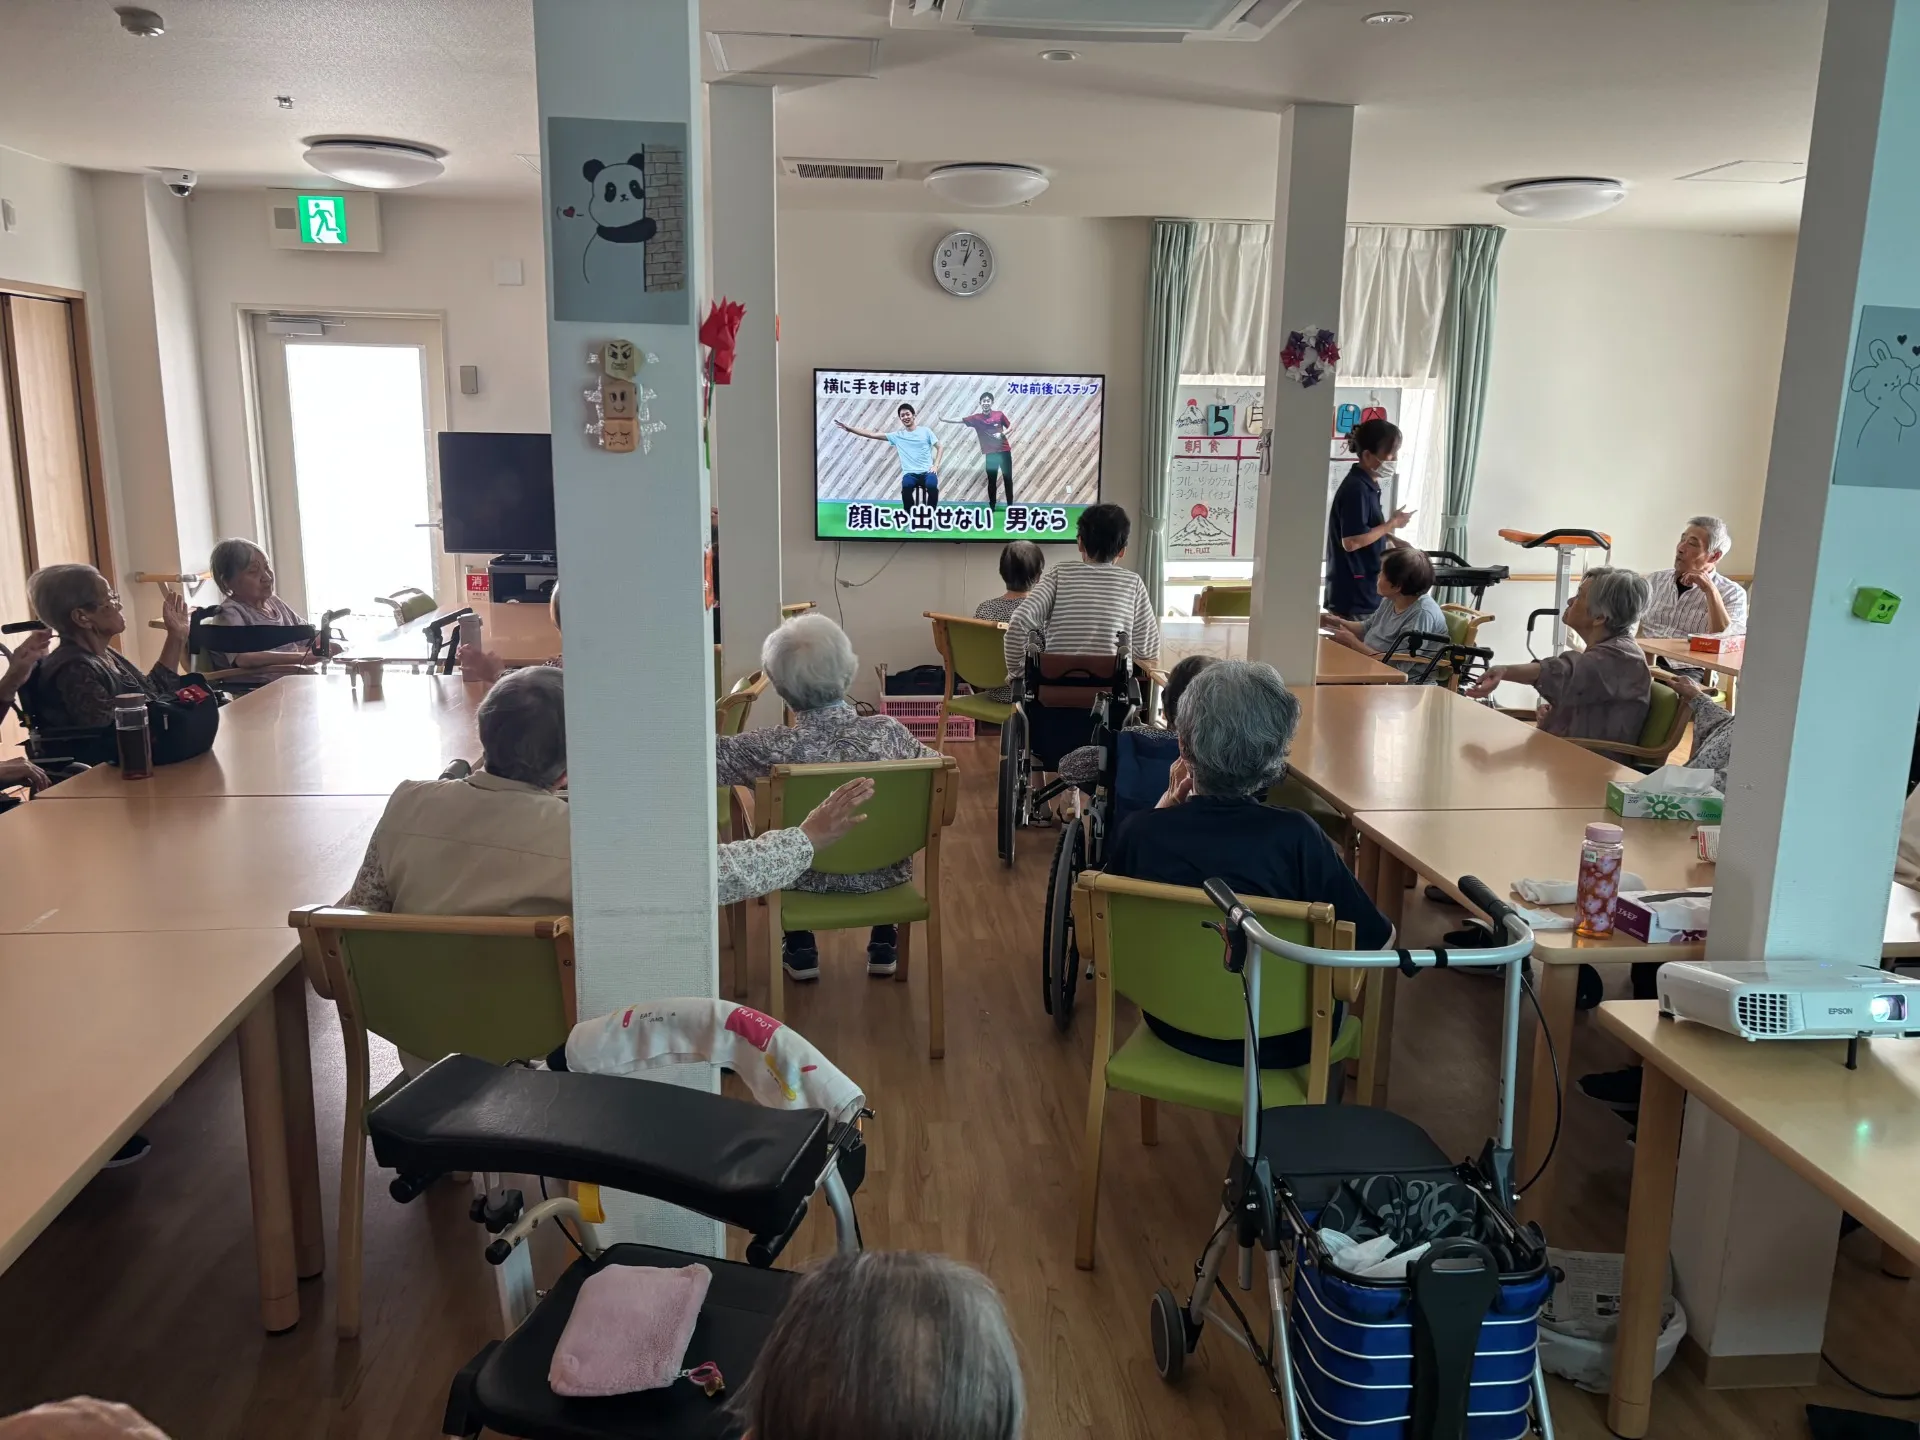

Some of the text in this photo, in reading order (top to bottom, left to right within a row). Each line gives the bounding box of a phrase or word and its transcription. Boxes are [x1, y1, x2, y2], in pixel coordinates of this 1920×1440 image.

[951, 242, 958, 250] 11
[960, 239, 968, 247] 12
[944, 249, 952, 257] 10
[979, 249, 985, 257] 2
[941, 260, 947, 268] 9
[981, 260, 988, 268] 3
[978, 270, 984, 278] 4
[971, 278, 977, 286] 5
[823, 377, 921, 396] 横に手を伸ばす
[1007, 381, 1099, 396] 次は前後にステップ
[847, 504, 1068, 532] 顔にゃ出せない 男なら
[1828, 1007, 1853, 1015] EPSON
[738, 1008, 773, 1030] TEA POT
